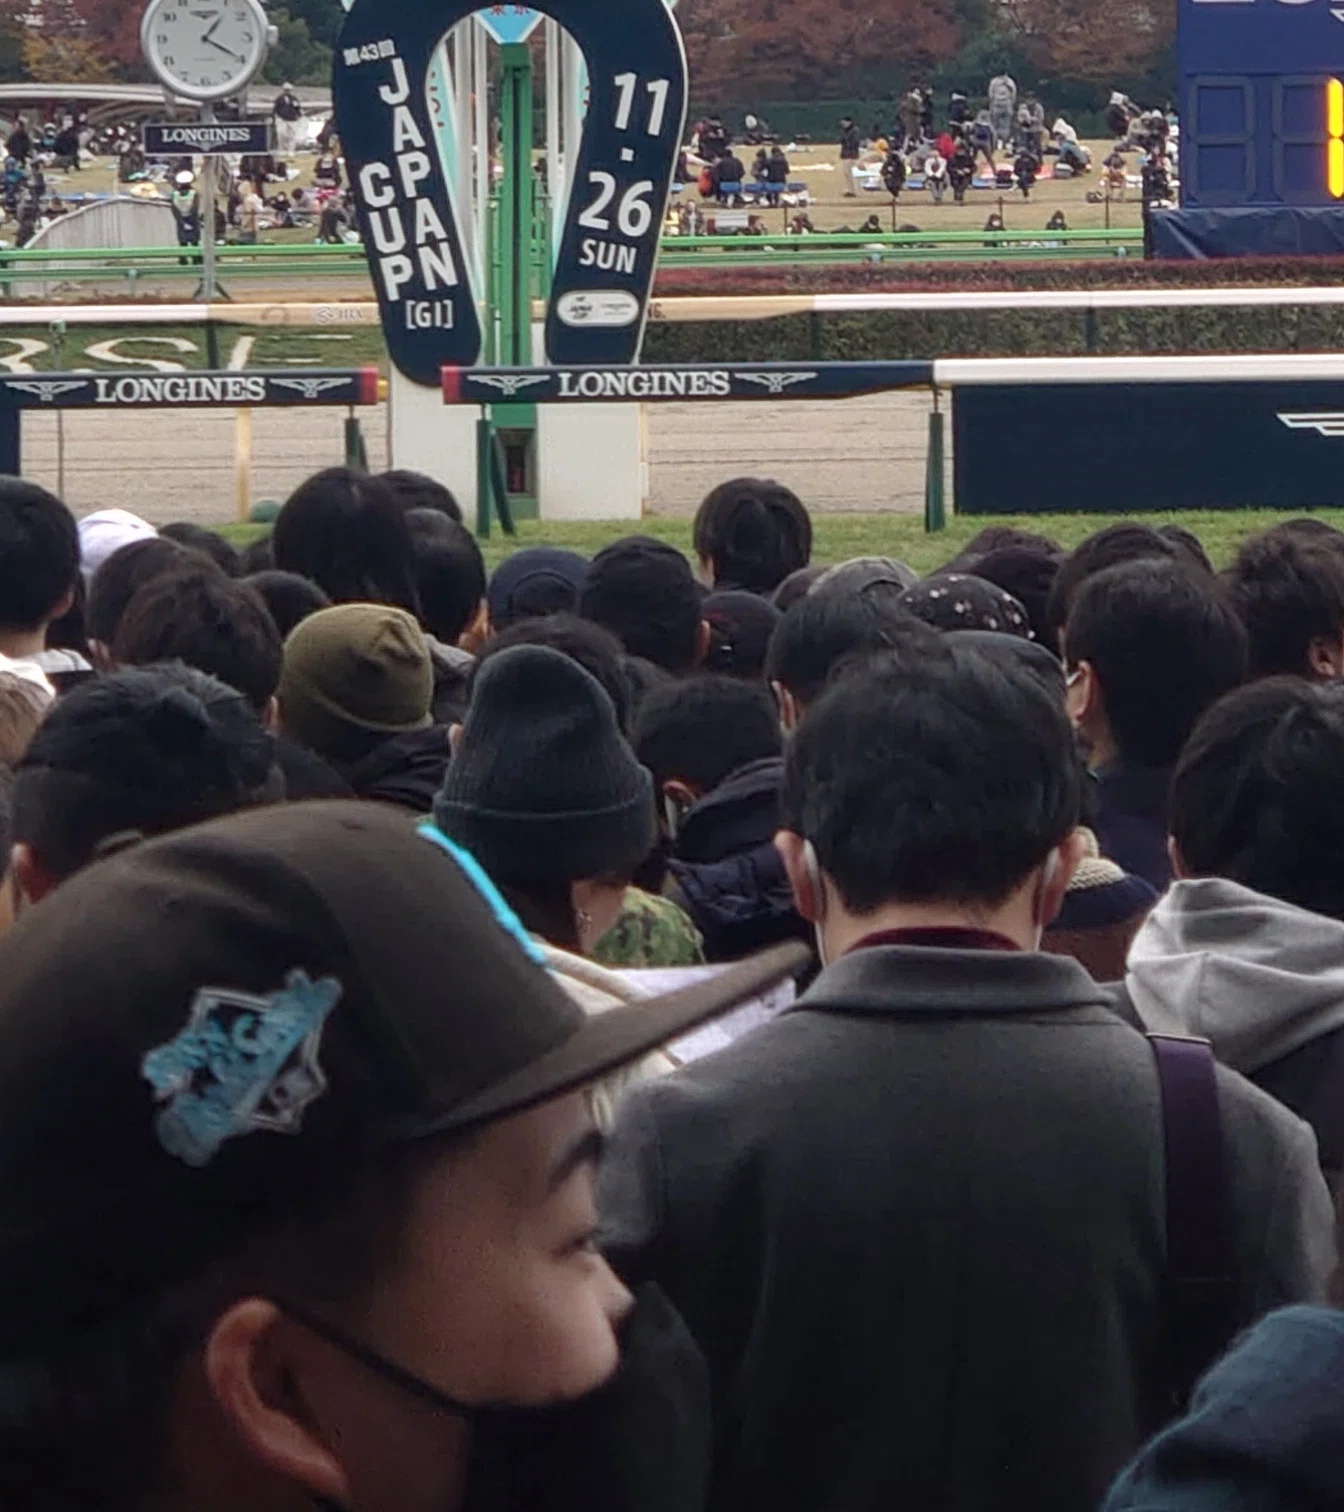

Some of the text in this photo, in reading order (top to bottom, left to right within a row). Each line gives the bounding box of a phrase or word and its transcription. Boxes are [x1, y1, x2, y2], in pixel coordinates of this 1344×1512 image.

[161, 127, 252, 143] LONGINES
[379, 57, 458, 291] JAPAN
[578, 170, 654, 239] 26
[359, 161, 413, 302] CUP
[579, 238, 637, 275] SUN
[94, 376, 267, 404] LONGINES
[556, 370, 731, 398] LONGINES
